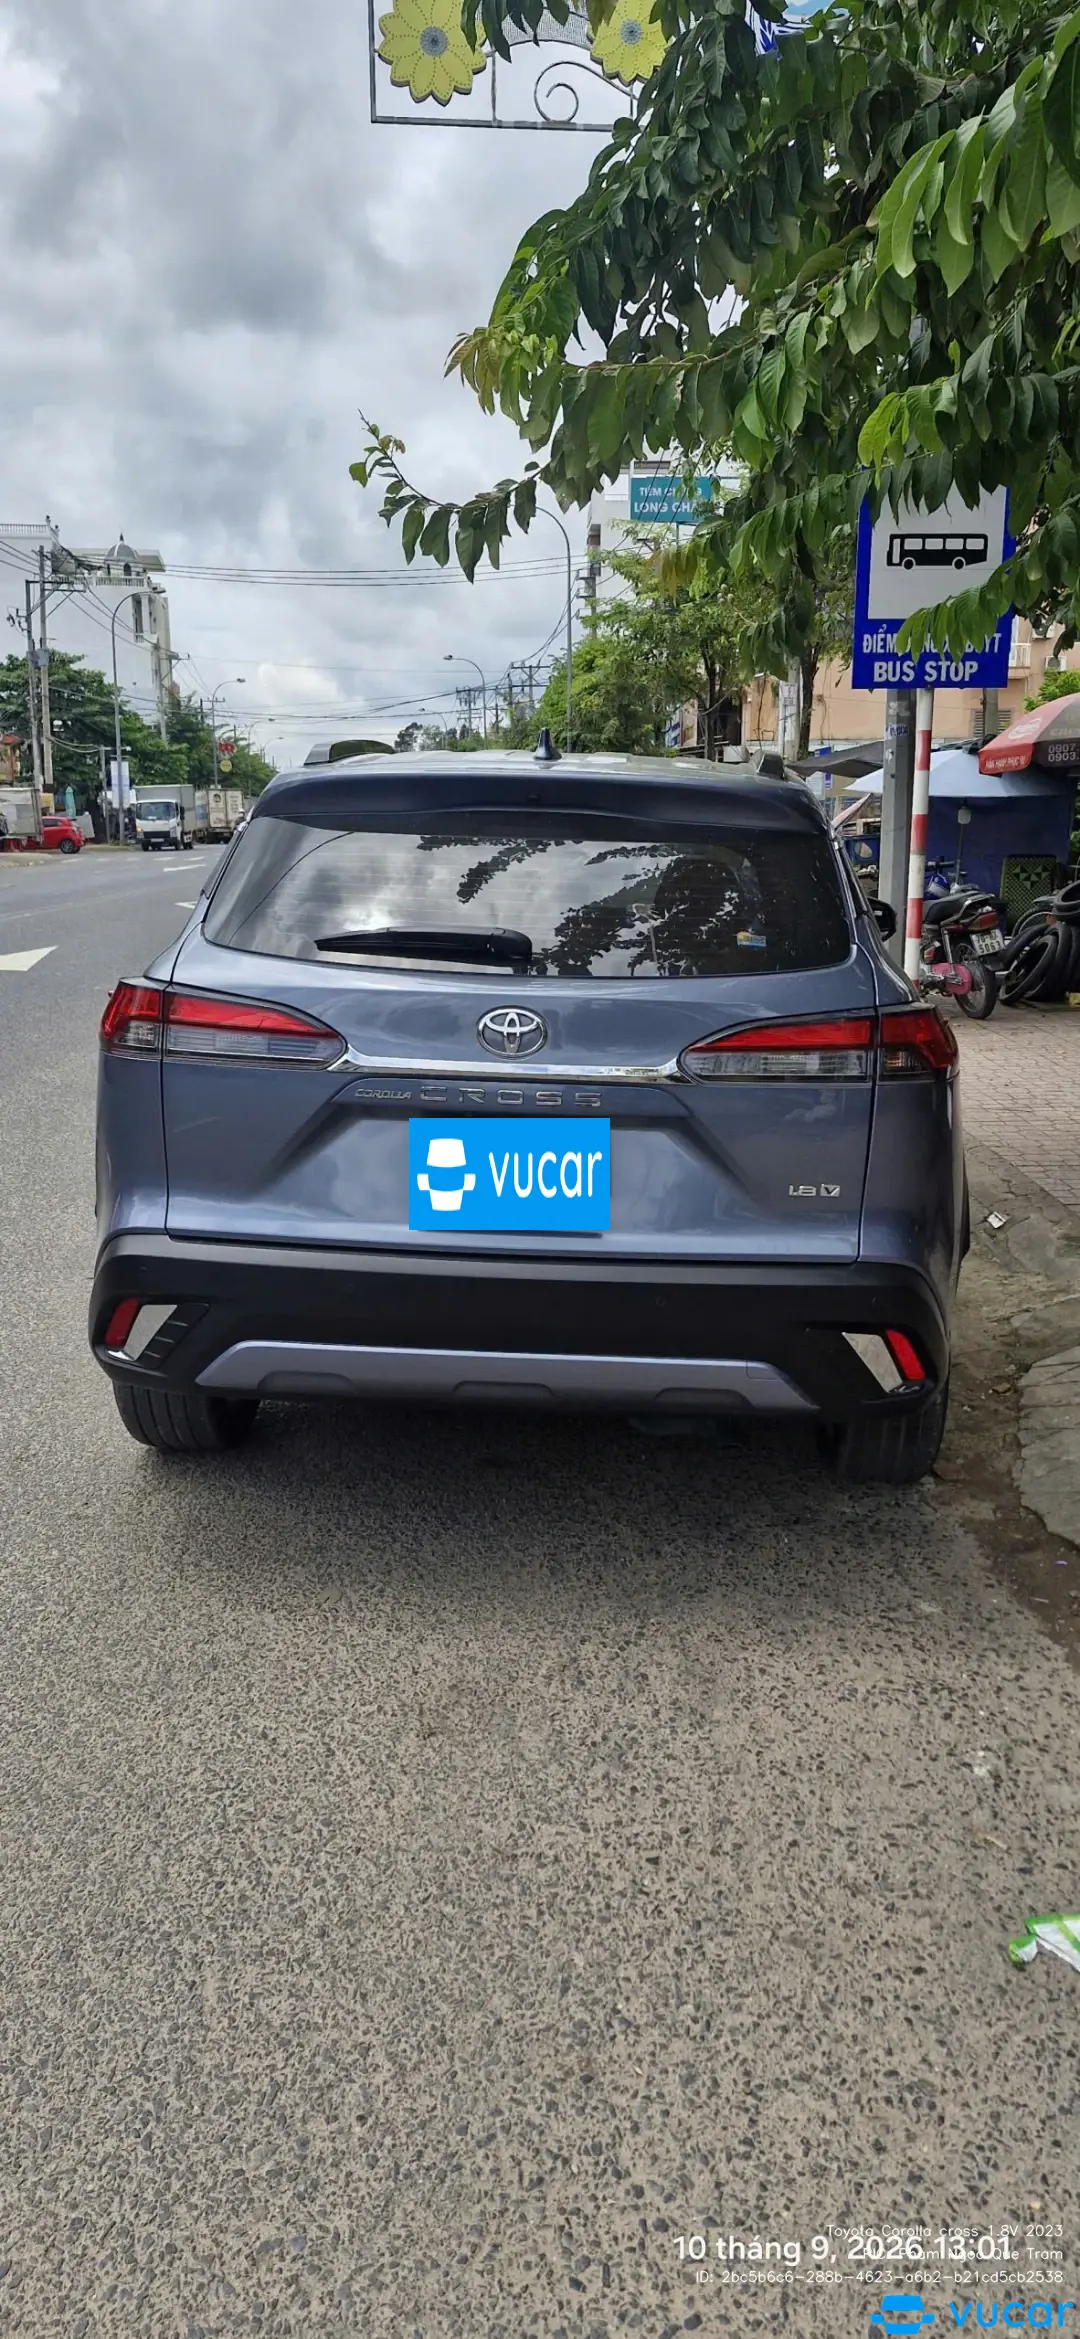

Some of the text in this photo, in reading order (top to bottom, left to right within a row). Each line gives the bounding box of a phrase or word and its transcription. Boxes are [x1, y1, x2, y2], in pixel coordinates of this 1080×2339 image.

[634, 501, 669, 513] LONG
[873, 661, 979, 682] BUS STOP
[420, 1085, 602, 1108] CROSS
